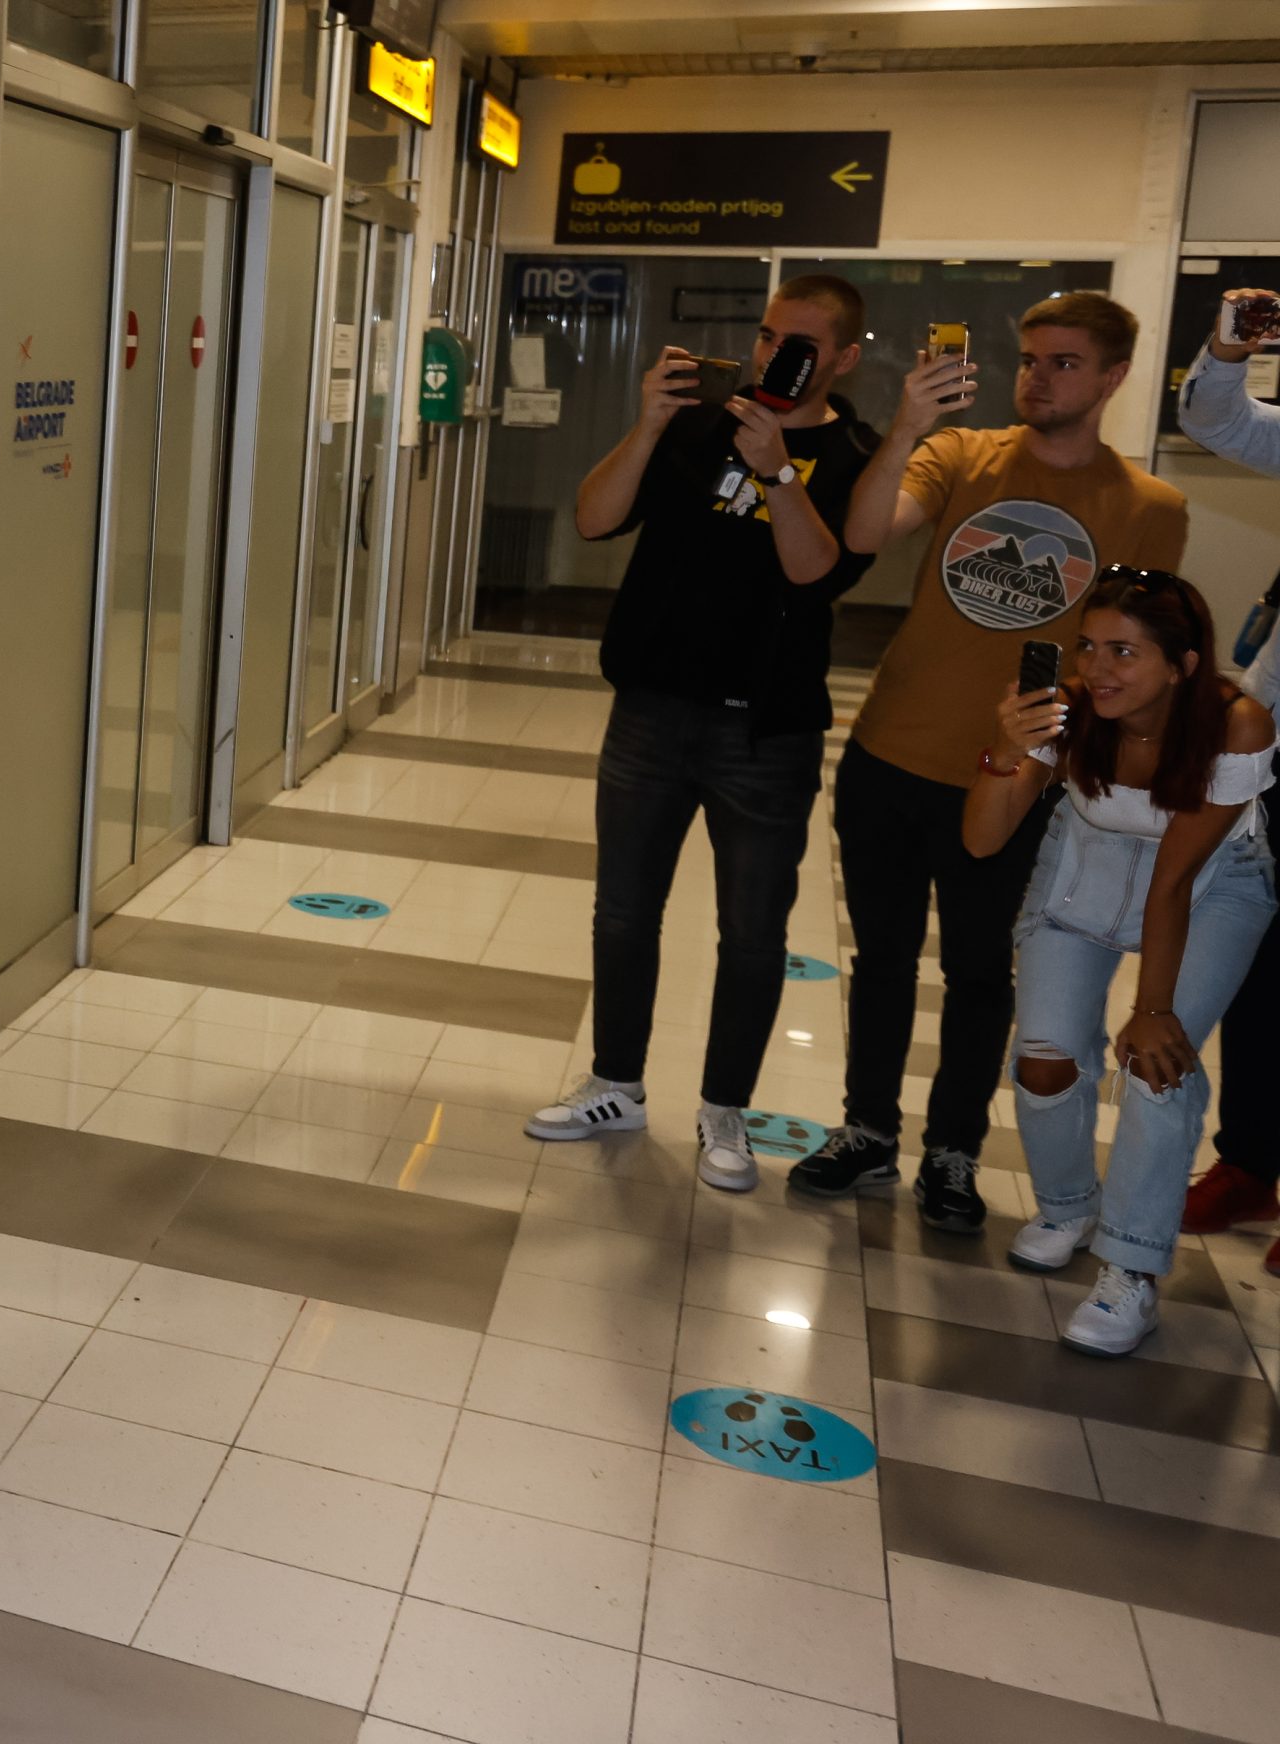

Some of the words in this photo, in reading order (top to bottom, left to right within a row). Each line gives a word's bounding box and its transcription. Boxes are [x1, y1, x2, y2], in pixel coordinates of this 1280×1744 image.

[568, 218, 600, 234] lost
[604, 219, 641, 235] and
[645, 218, 701, 235] found
[16, 380, 76, 408] BELGRADE
[1006, 591, 1046, 617] LUST
[721, 1432, 831, 1472] TAXI
